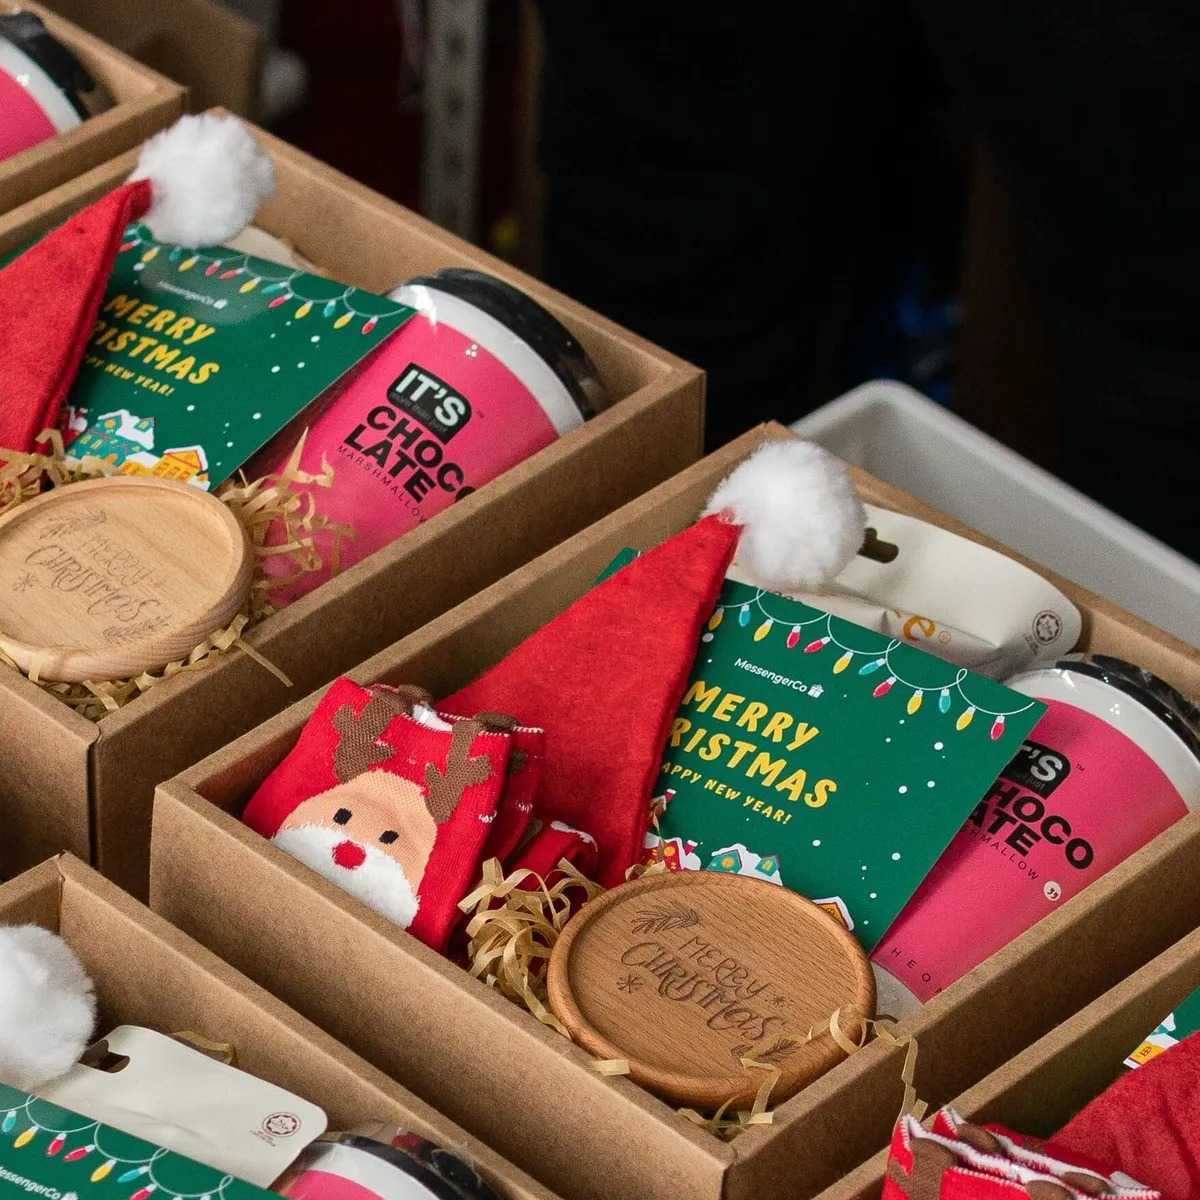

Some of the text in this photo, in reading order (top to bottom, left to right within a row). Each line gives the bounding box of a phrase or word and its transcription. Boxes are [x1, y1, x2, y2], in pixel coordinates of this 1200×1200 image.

[104, 295, 216, 345] MERRY
[94, 320, 220, 384] ISTMAS
[395, 369, 466, 427] IT'S
[343, 424, 437, 503] LATE
[734, 657, 808, 693] MessengerCo
[681, 680, 820, 752] MERRY
[662, 762, 793, 825] APPY NEW YEAR!
[669, 717, 838, 808] RISTMAS
[969, 801, 1042, 857] ATE
[985, 783, 1094, 870] HOCO
